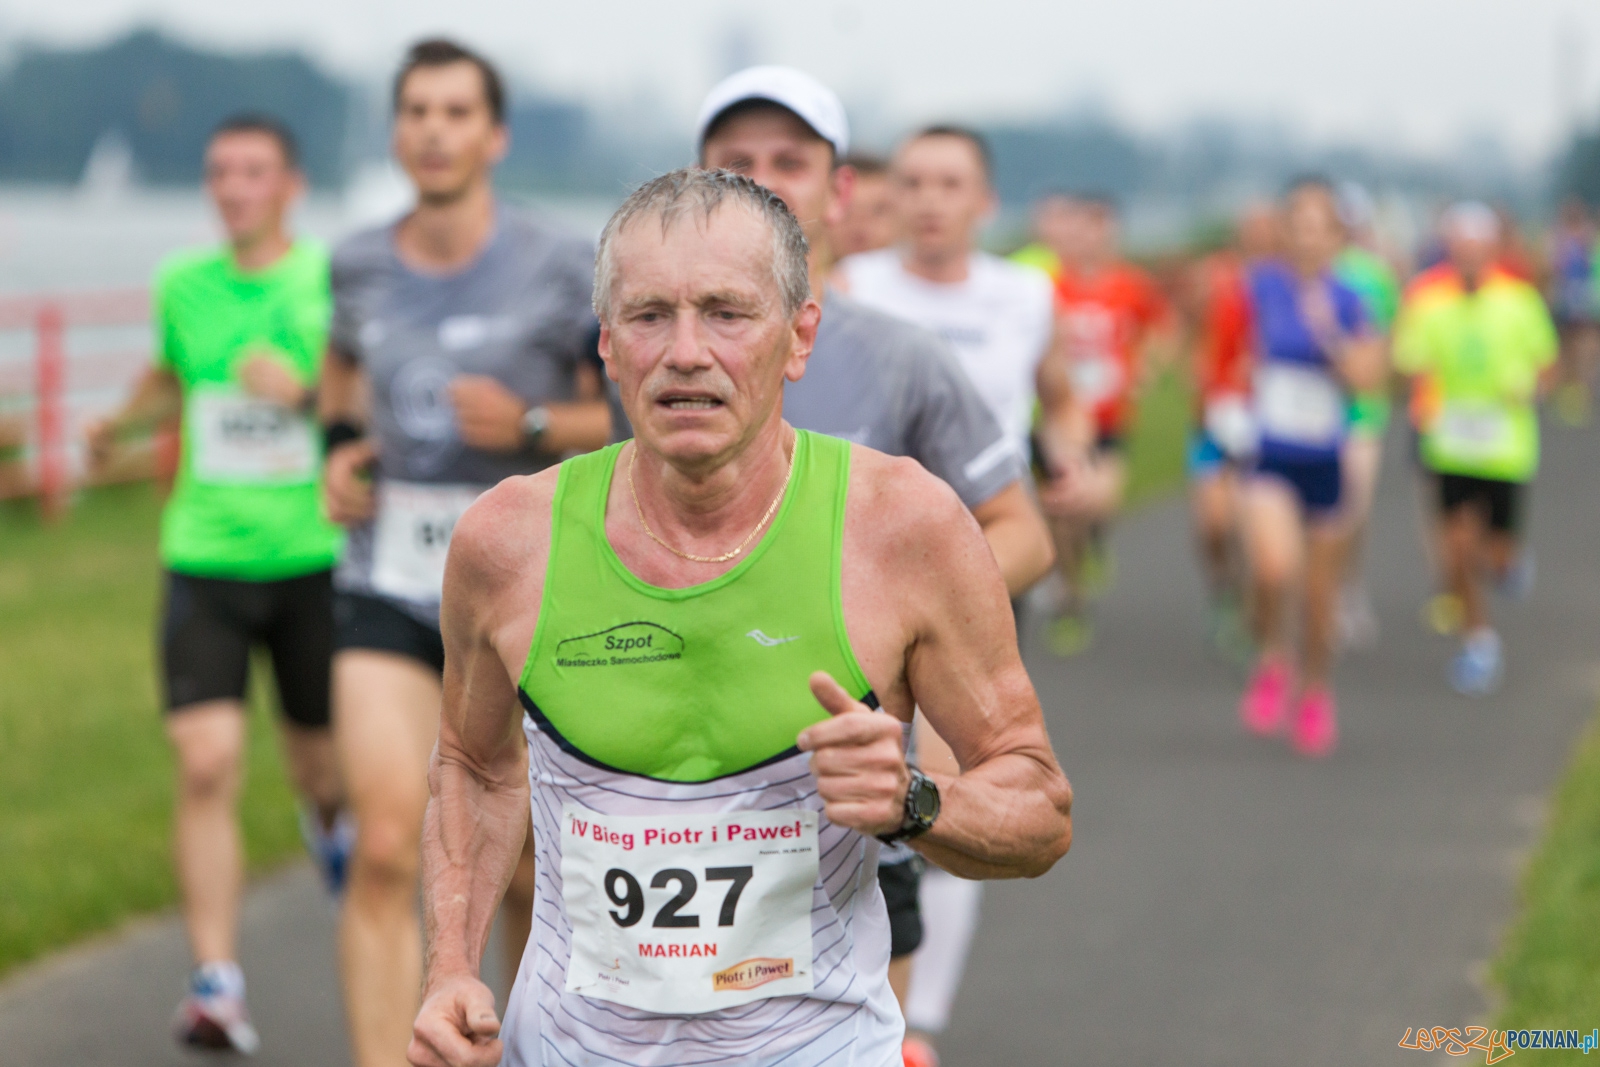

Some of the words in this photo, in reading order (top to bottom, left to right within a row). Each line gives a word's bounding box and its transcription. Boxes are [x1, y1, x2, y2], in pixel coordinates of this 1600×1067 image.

[604, 634, 653, 652] Szpot
[556, 656, 608, 667] Miasteczko
[609, 651, 682, 666] Samochodowe
[571, 817, 588, 838] IV
[592, 823, 635, 851] Bieg
[643, 827, 703, 847] Piotr
[711, 826, 718, 842] i
[727, 821, 802, 842] Paweł
[604, 865, 754, 929] 927
[638, 943, 718, 958] MARIAN
[716, 970, 745, 986] Piotr
[748, 968, 752, 979] i
